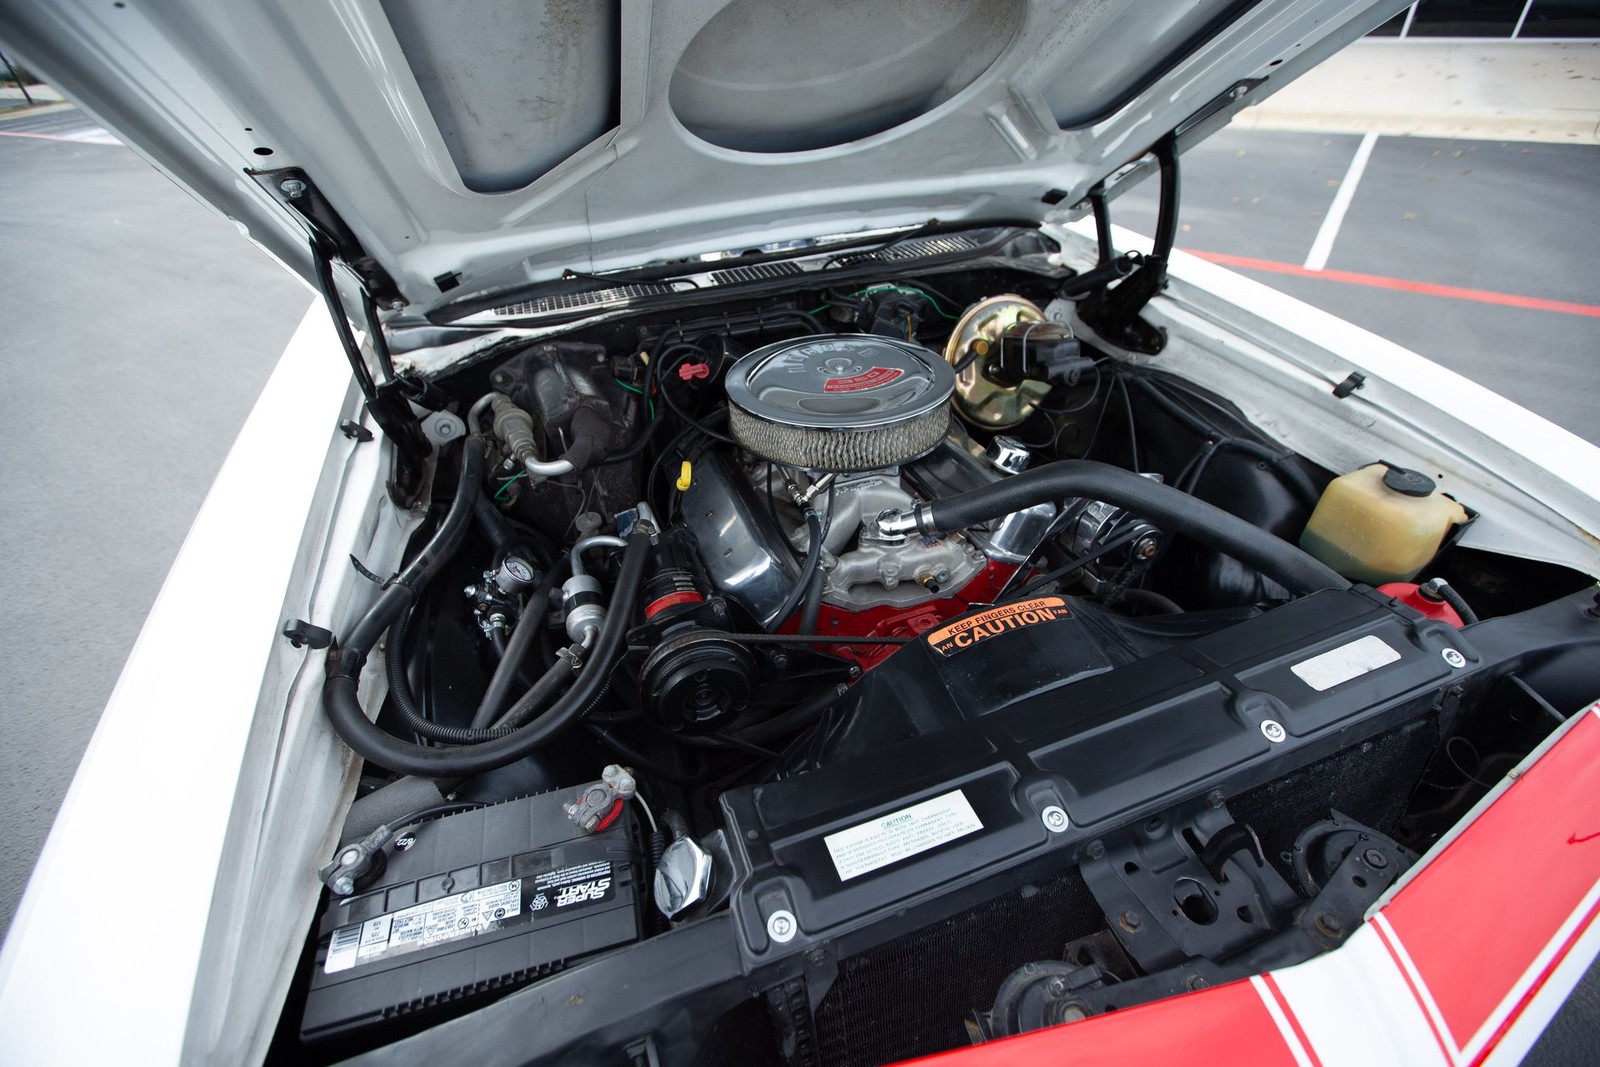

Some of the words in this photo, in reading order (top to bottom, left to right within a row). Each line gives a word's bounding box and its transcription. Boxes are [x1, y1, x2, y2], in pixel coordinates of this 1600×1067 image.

[947, 620, 973, 636] KEEP
[975, 606, 1017, 624] FINGERS
[1017, 600, 1047, 613] CLEAR
[938, 641, 954, 652] AN
[954, 607, 1056, 648] CAUTION
[1052, 608, 1068, 616] FAN
[880, 813, 913, 827] CAUTION
[396, 838, 413, 847] 8/22
[555, 877, 611, 899] START
[557, 889, 605, 907] SUPER
